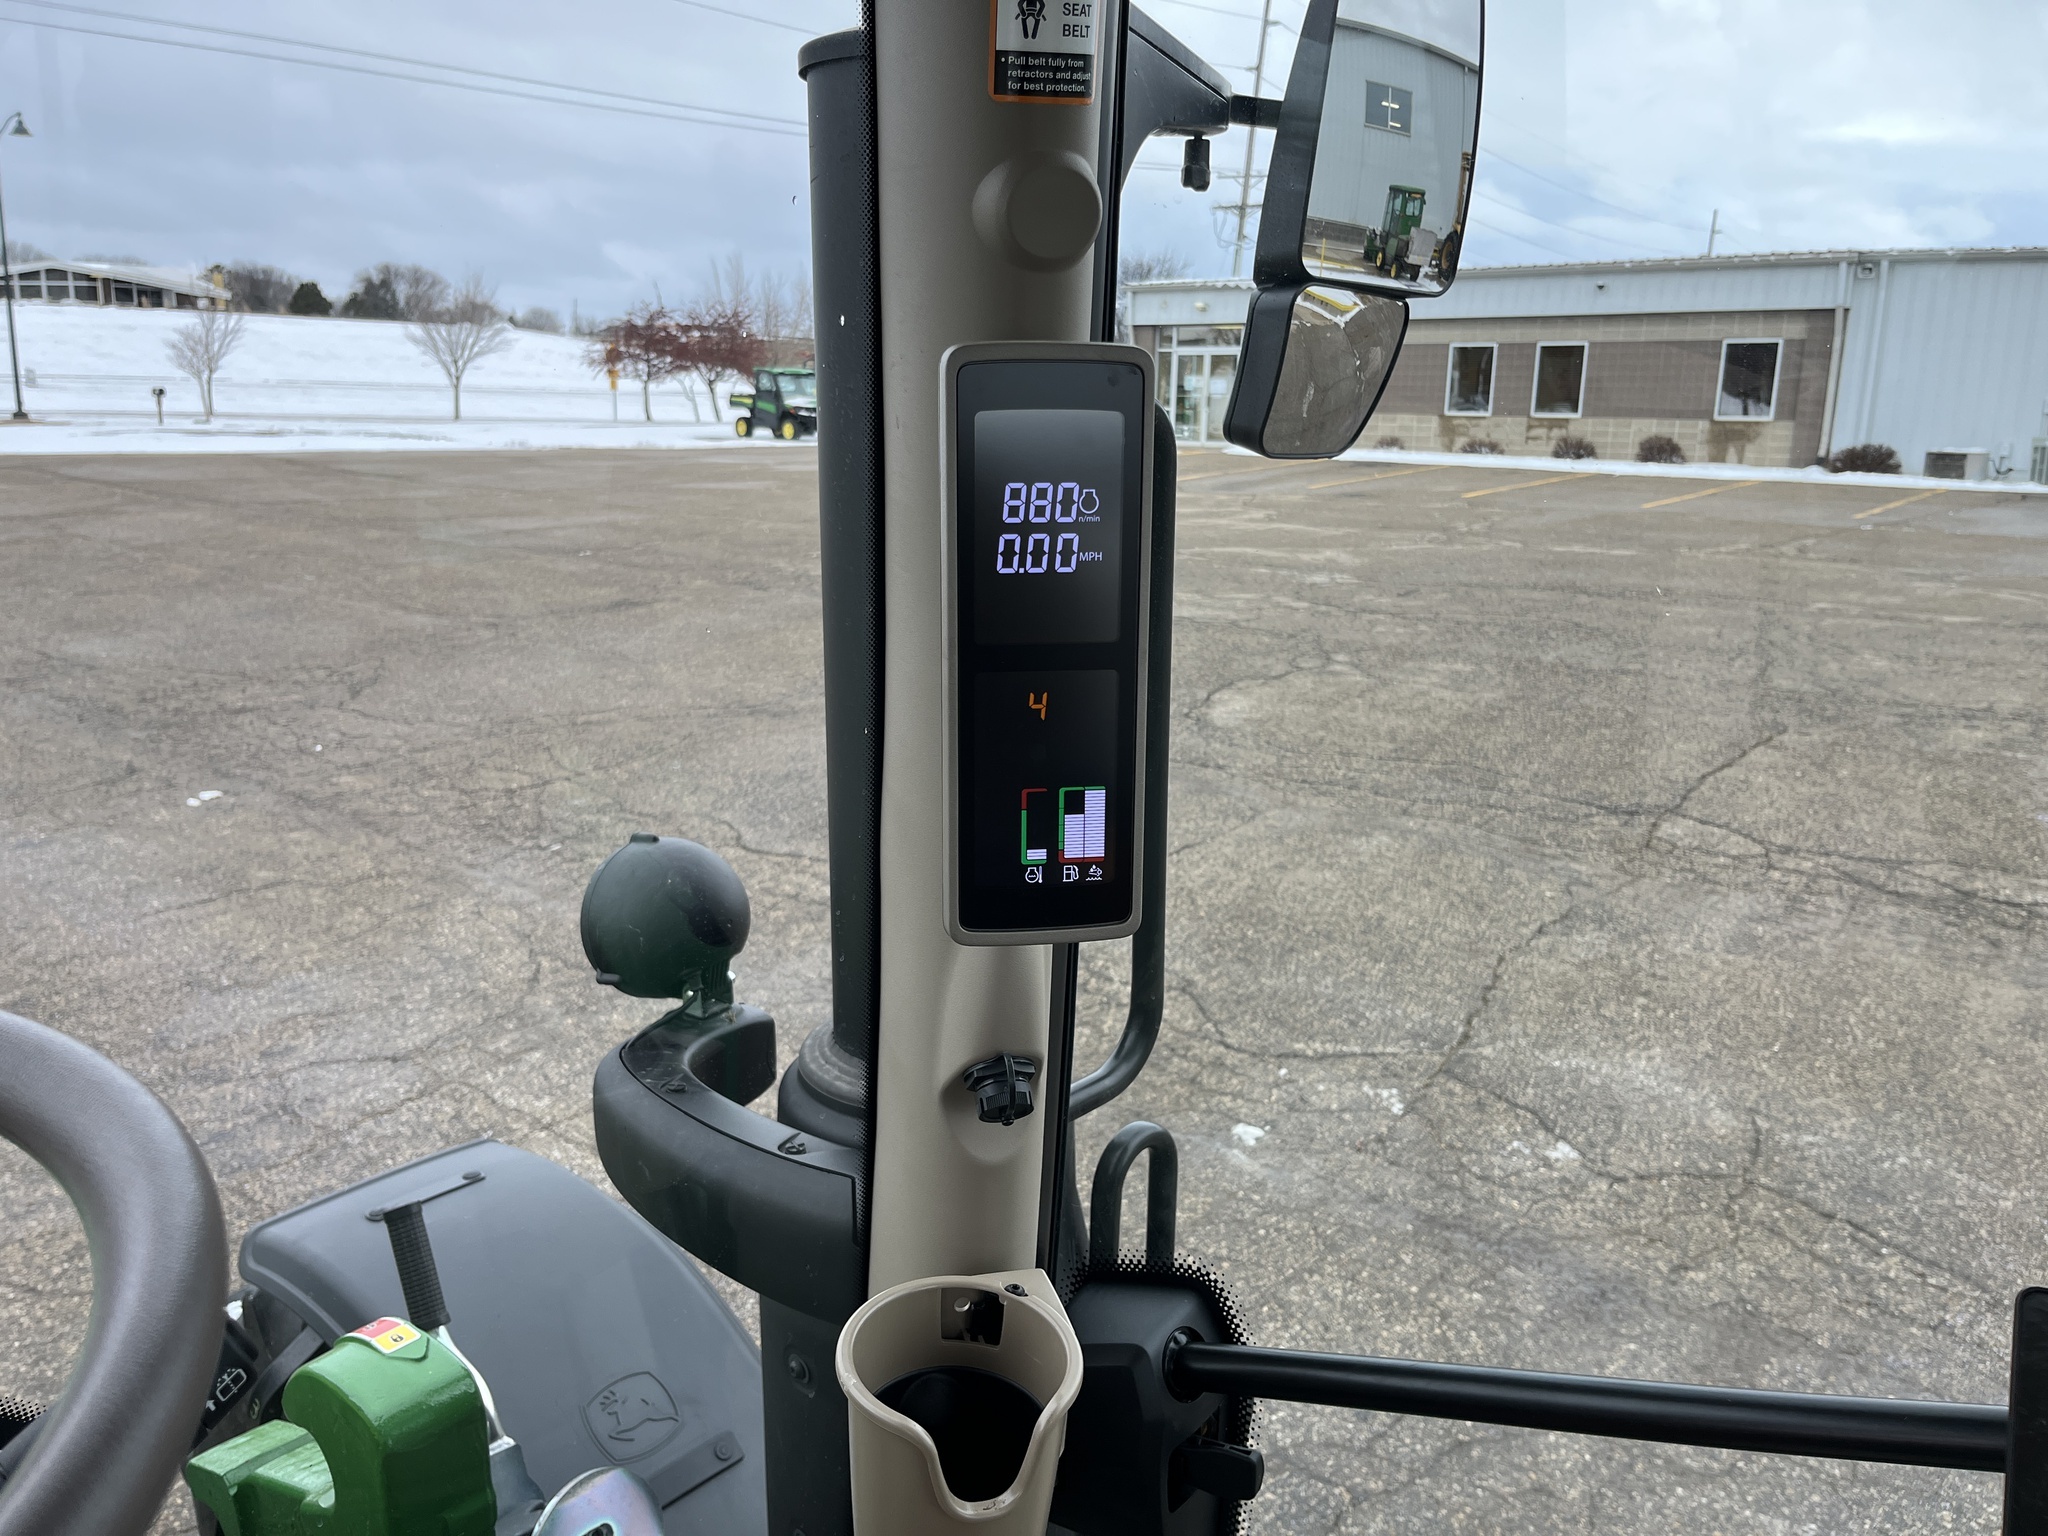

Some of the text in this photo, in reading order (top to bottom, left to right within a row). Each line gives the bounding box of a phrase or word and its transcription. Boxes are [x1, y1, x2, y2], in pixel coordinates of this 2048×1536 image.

[1062, 2, 1092, 17] SEAT
[1062, 24, 1091, 38] BELT
[1008, 56, 1084, 68] Pull belt fully from
[1008, 69, 1091, 82] retractors and adjust
[1008, 81, 1086, 93] for best protection.
[1002, 482, 1101, 524] 880 n/min
[996, 533, 1103, 574] 0.00 MPH
[1029, 691, 1048, 721] 4
